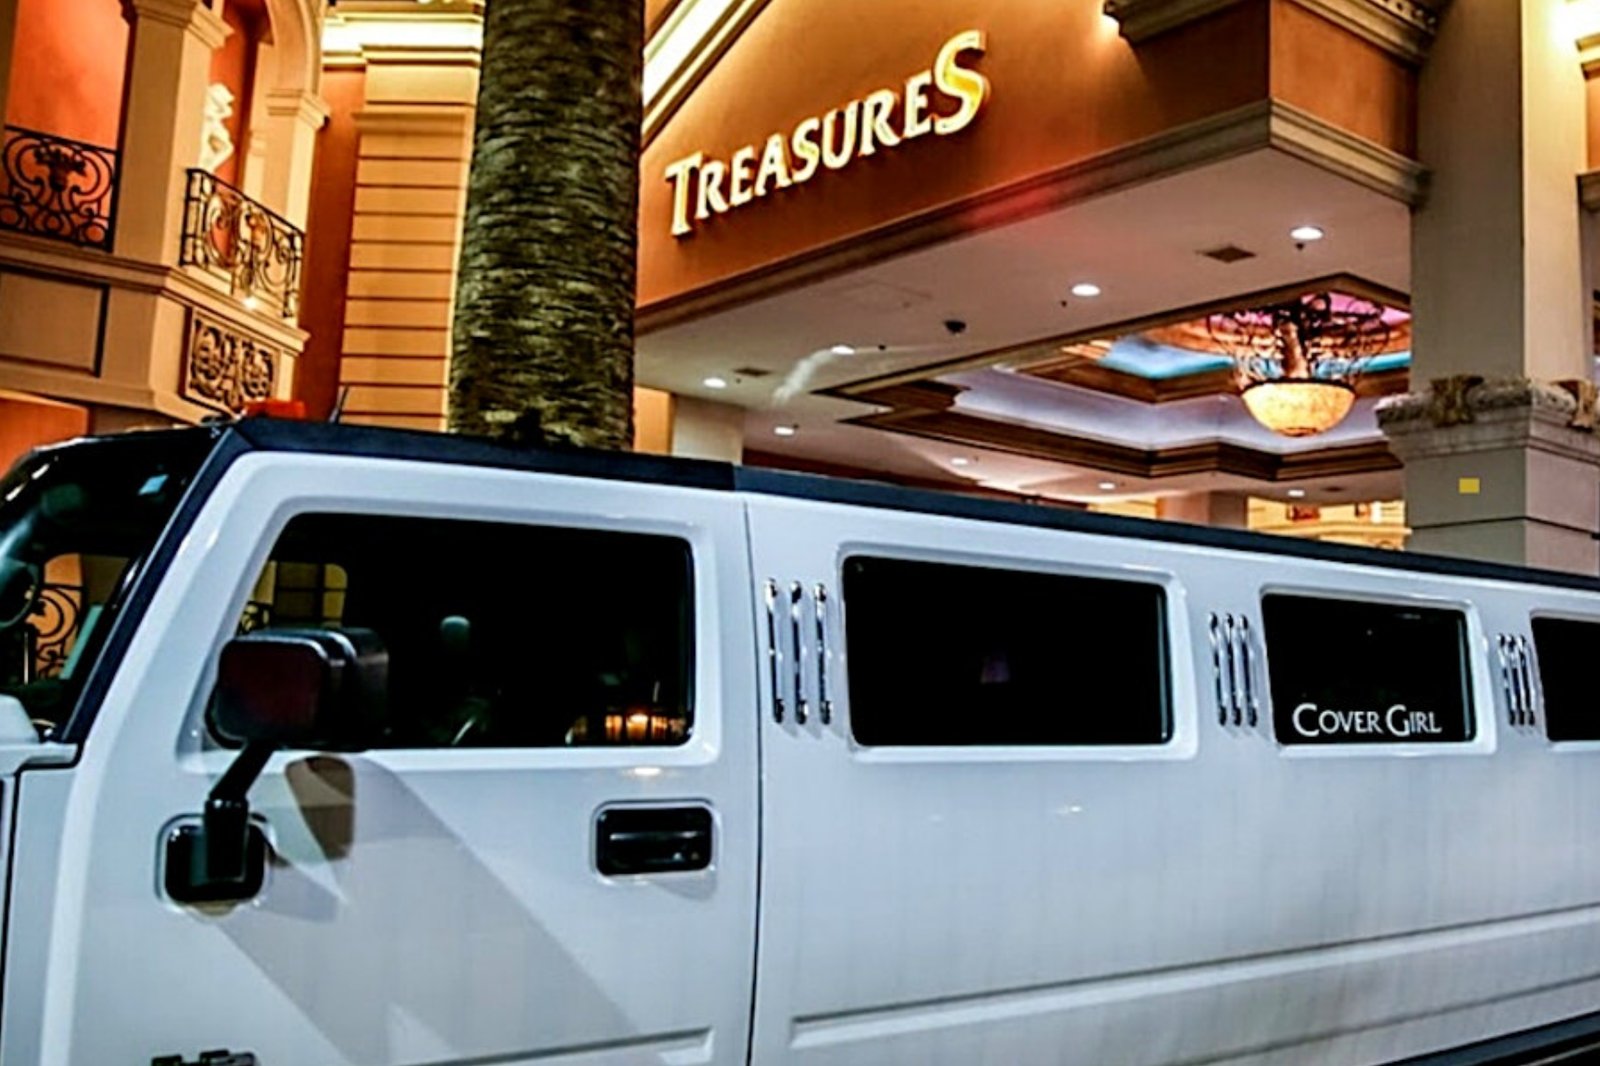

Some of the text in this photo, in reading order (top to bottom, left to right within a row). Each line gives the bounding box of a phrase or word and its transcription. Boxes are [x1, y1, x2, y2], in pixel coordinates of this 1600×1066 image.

[664, 29, 989, 236] TREASURES
[1292, 702, 1443, 738] COVER GIRL
